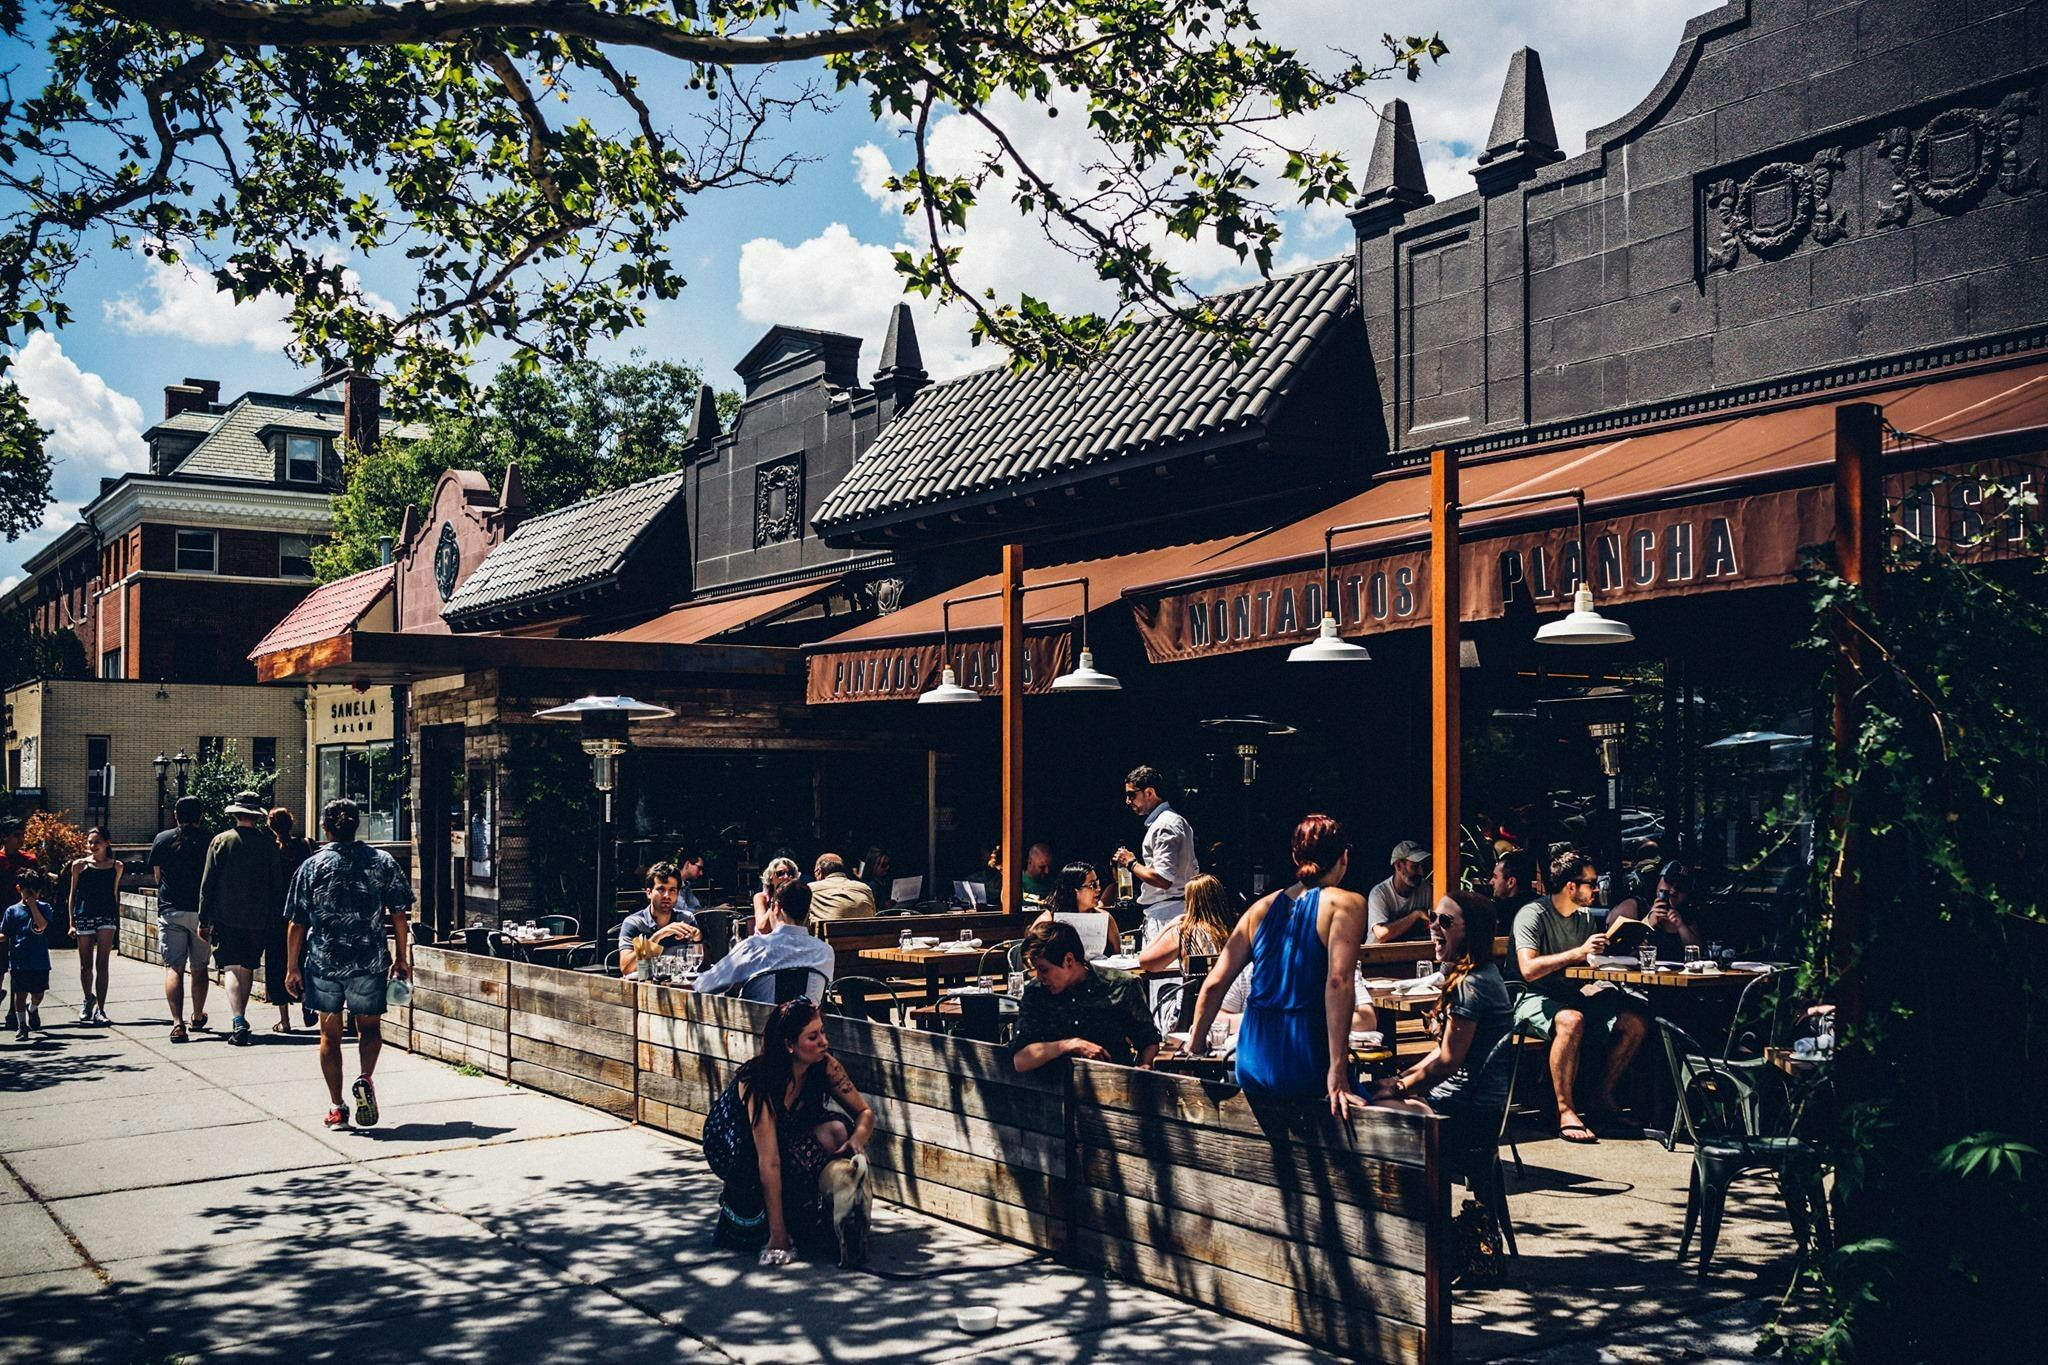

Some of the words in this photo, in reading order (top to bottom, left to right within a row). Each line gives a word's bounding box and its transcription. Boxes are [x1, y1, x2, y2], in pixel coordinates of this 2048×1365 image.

[1188, 566, 1414, 648] MONTADITOS
[1500, 517, 1738, 603] PLANCHA
[834, 654, 920, 695] PINTXOS
[956, 648, 1033, 688] TAPS
[331, 699, 376, 718] SANELA
[334, 721, 373, 734] SALON
